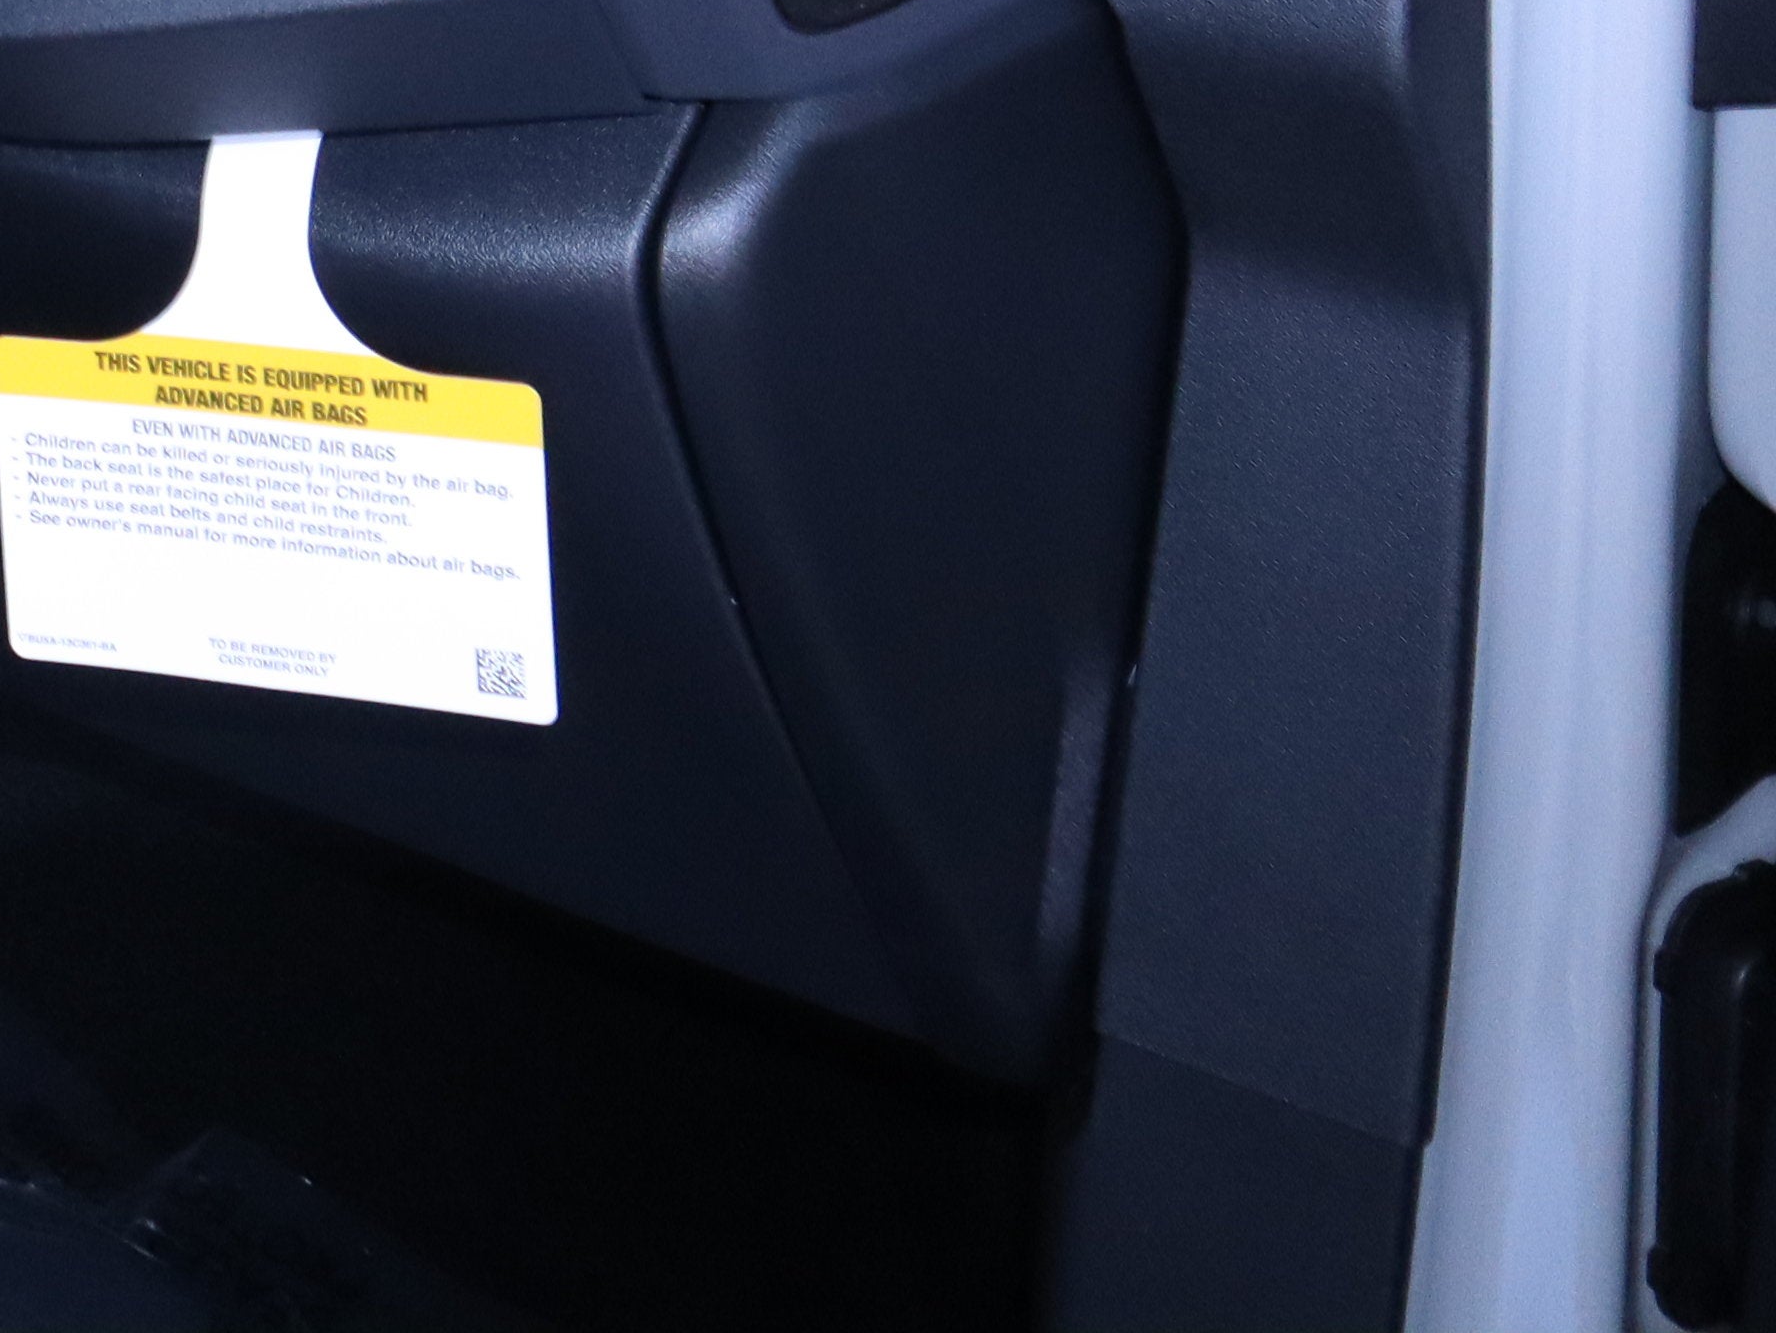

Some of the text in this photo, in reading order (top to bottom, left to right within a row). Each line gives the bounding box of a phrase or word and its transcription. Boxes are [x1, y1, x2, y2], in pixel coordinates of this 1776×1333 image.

[95, 351, 429, 402] THIS VEHICLE IS EQUIPPED WITH
[155, 386, 368, 426] ADVANCED AIR BAGS
[131, 419, 396, 462] EVEN WITH ADVANCED AIR BAGS
[24, 433, 514, 501] Children can be killed or seriously injured by the air bag.
[25, 451, 415, 508] The back seat is the safest place for Children.
[27, 471, 412, 528] Never put a rear facing child seat in the front.
[29, 491, 388, 544] Always use seat belts and child restraints.
[30, 510, 521, 581] See owner's manual for more information about air bags.
[208, 637, 337, 664] TO BE REMOVED BY
[218, 653, 329, 678] CUSTOMER ONLY
